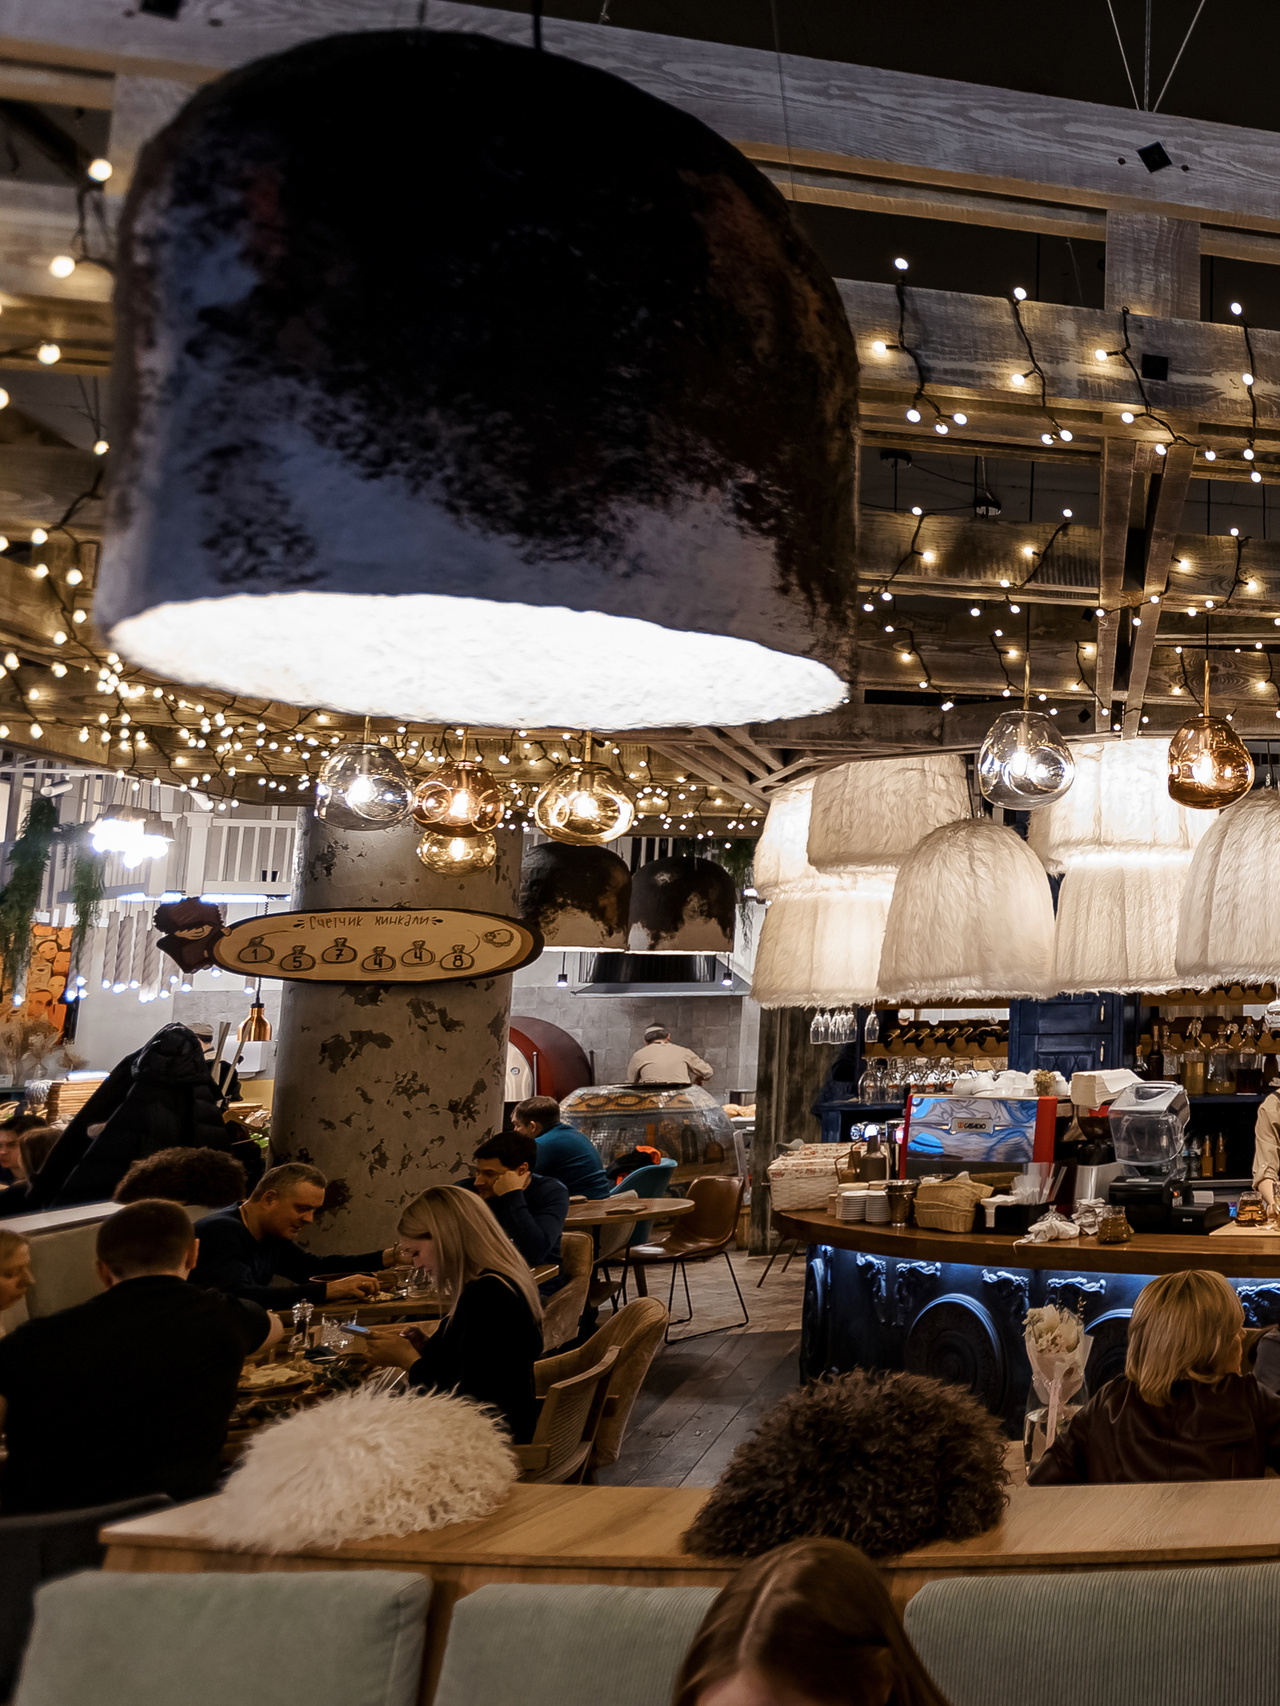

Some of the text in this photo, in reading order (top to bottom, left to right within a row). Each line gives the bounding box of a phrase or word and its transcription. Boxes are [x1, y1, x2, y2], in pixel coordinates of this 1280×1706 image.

[251, 948, 463, 969] 1 5 7 4 4 8
